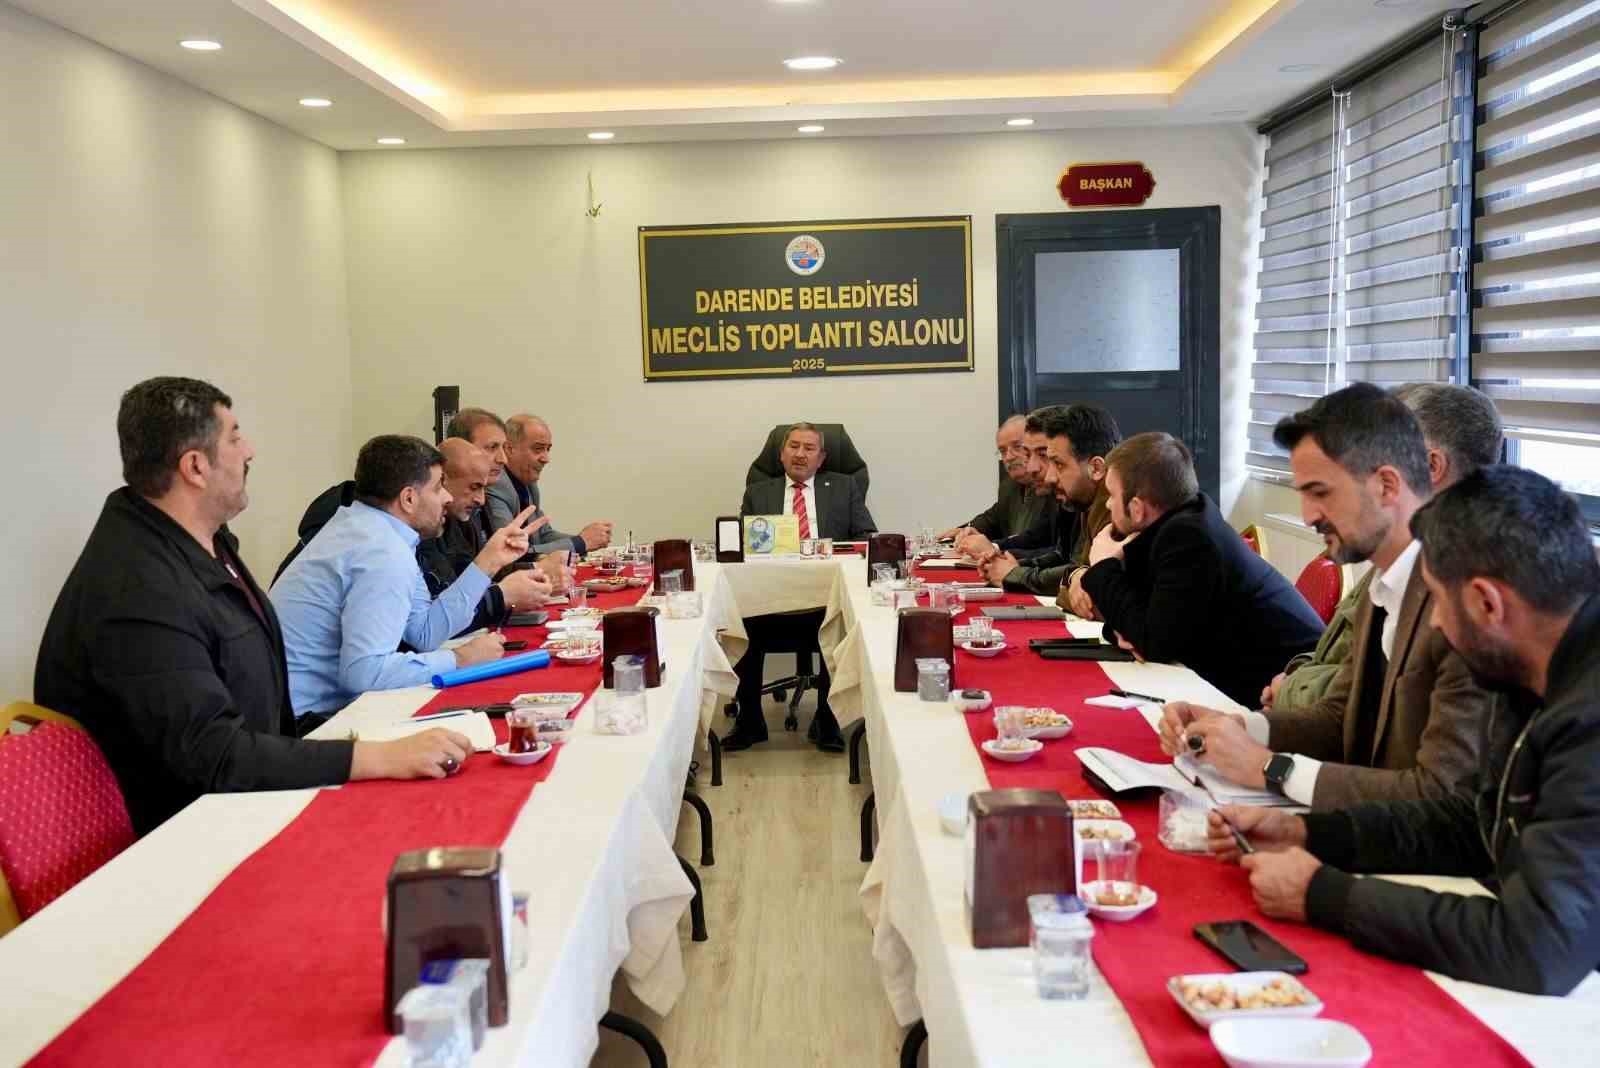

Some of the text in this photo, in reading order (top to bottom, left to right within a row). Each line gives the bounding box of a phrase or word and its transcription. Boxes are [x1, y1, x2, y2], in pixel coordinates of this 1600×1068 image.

[1080, 178, 1132, 192] BAŞKAN
[695, 278, 918, 313] DARENDE BELEDİYESİ
[651, 318, 964, 354] MECLİS TOPLANTI SALONU
[792, 358, 825, 369] 2025
